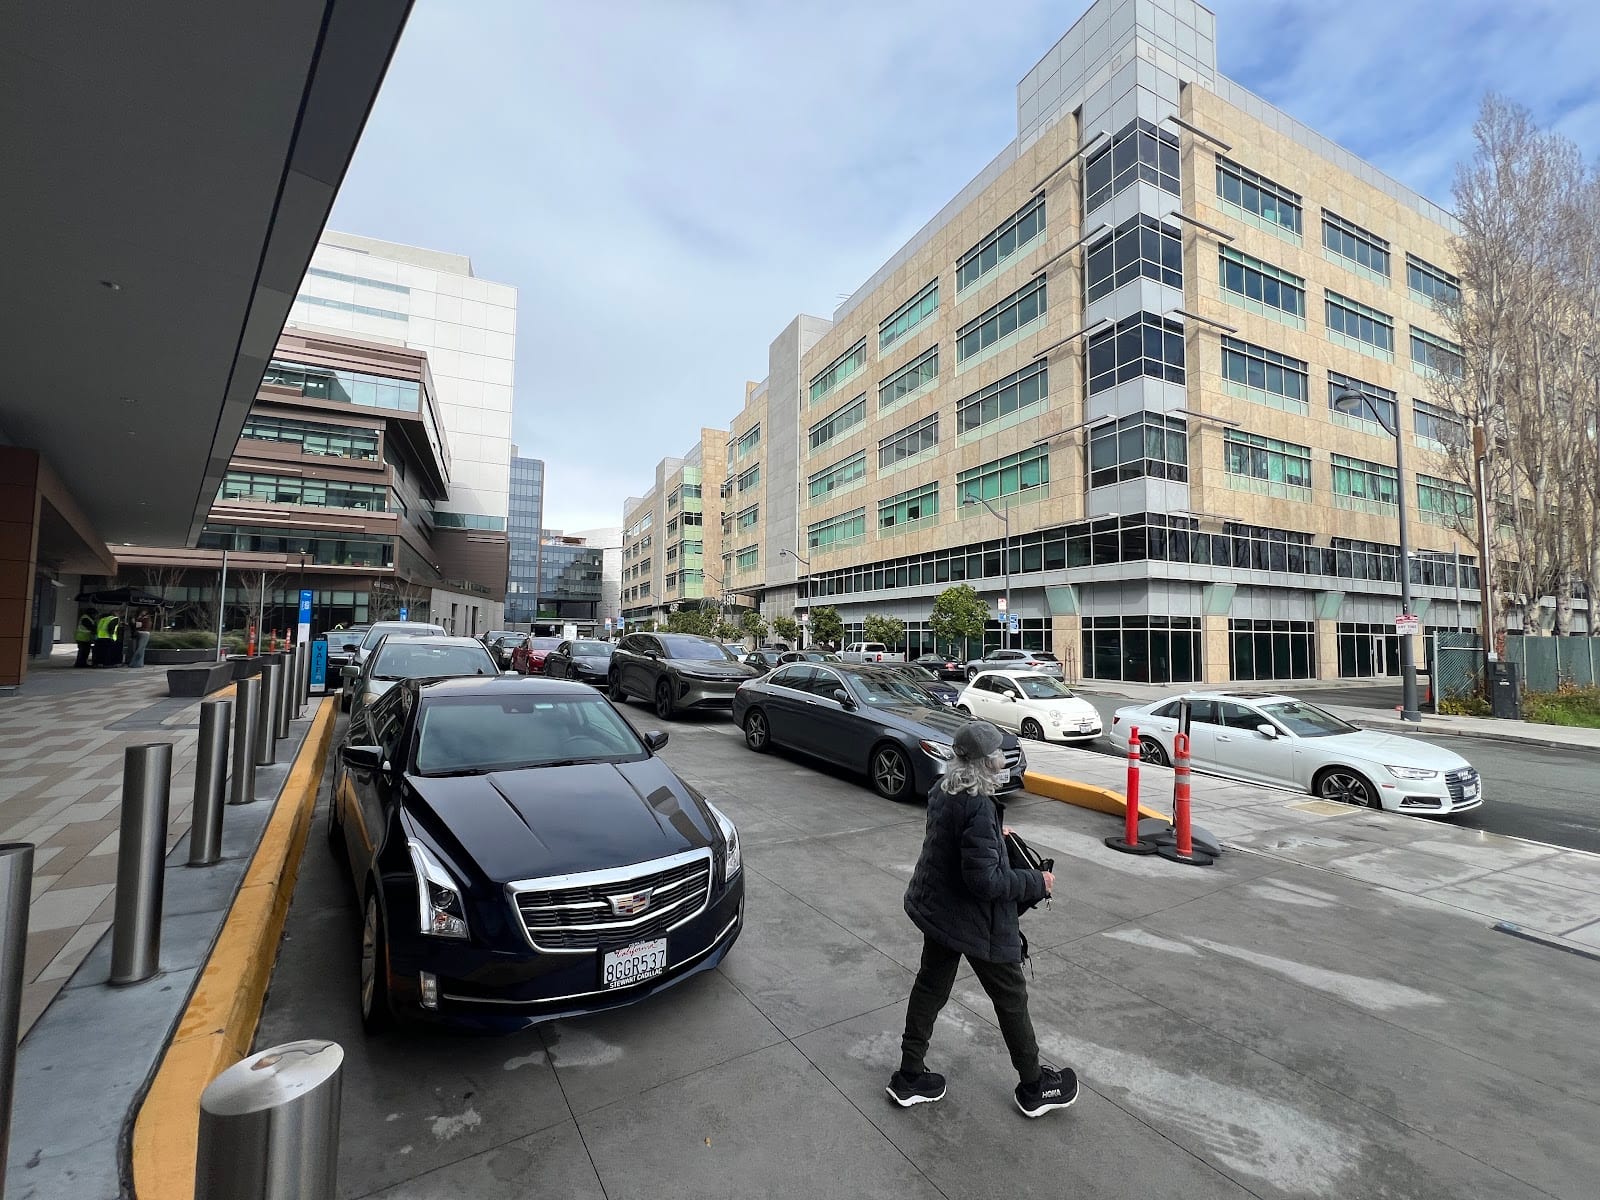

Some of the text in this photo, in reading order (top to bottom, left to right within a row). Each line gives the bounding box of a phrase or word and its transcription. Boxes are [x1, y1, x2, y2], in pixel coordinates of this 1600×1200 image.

[615, 944, 657, 957] California
[606, 949, 665, 982] 8GGR537
[609, 968, 662, 988] STEWART CADILLAC
[1042, 1089, 1061, 1098] HOKA
